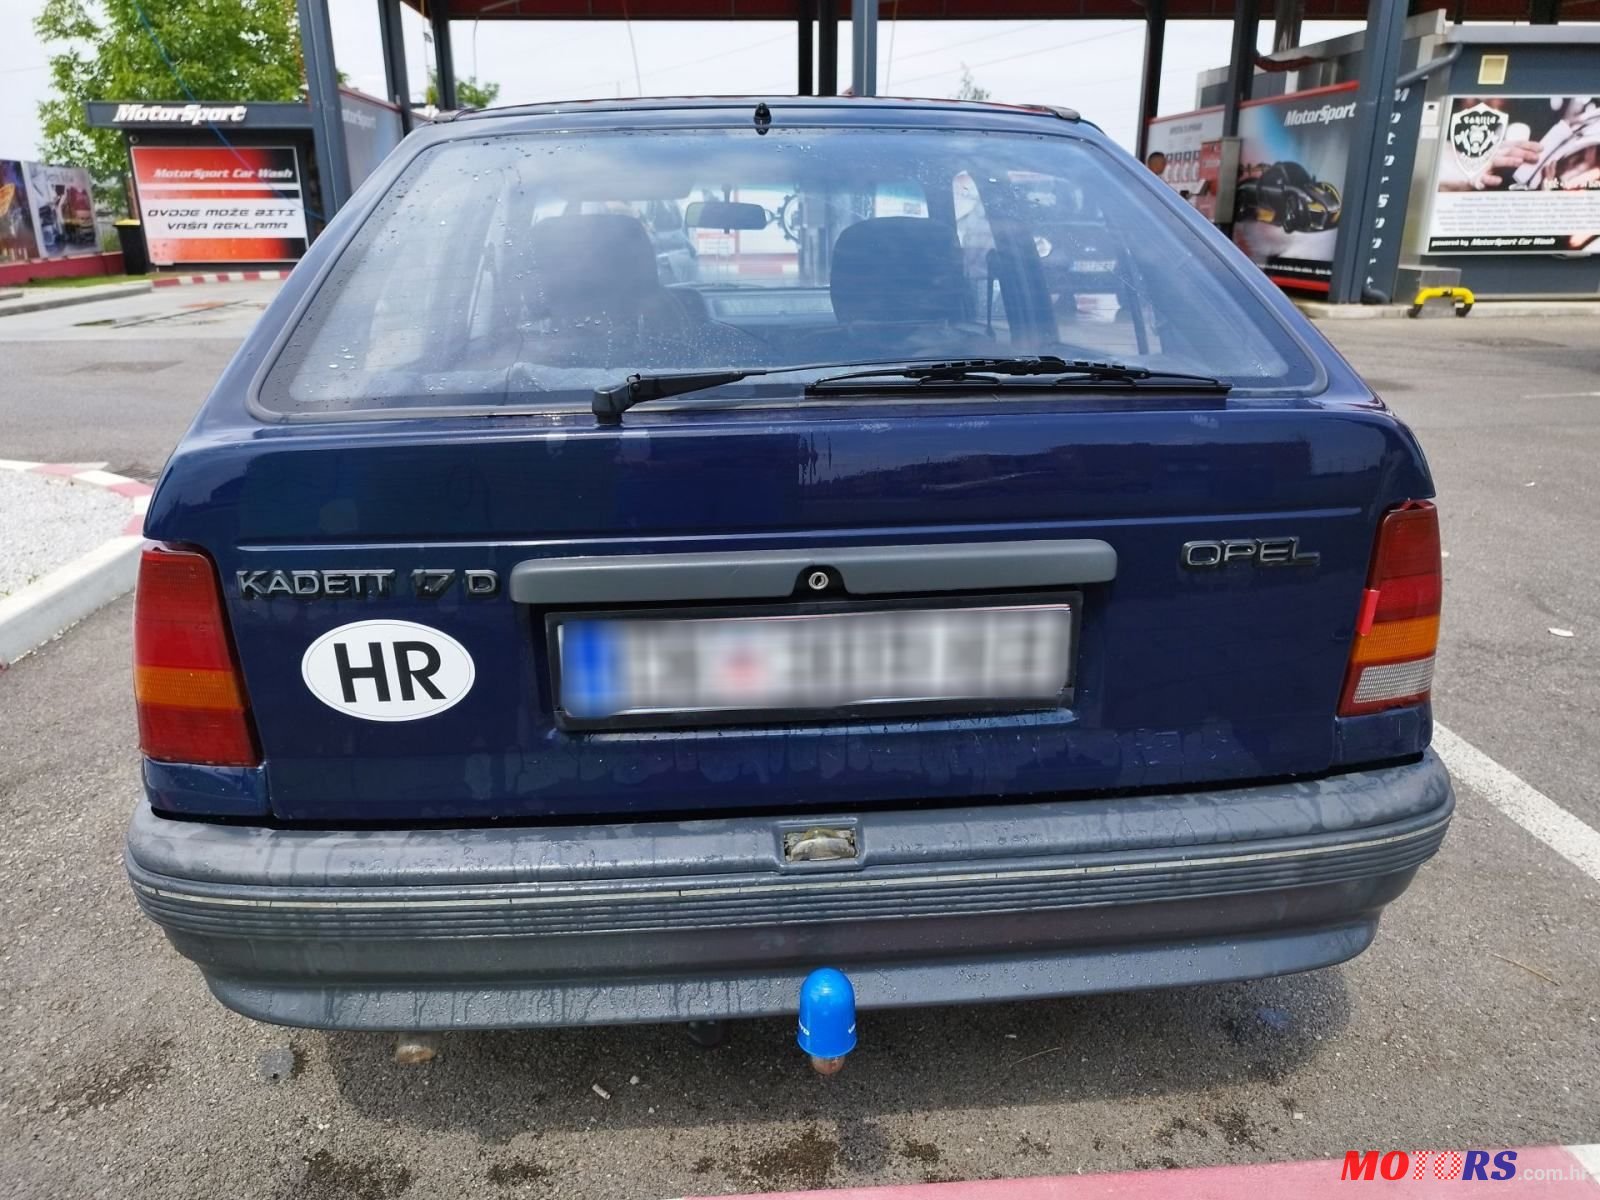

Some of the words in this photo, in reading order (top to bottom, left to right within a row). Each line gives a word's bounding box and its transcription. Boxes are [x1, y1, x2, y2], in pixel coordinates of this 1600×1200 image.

[112, 104, 247, 125] MotorSport
[1284, 102, 1357, 127] MotorSport
[153, 168, 230, 179] MotorSport
[231, 168, 255, 179] Car
[256, 168, 294, 178] Wash
[205, 206, 250, 217] MOŽE
[254, 208, 297, 217] BITI
[167, 221, 208, 231] VAŠA
[212, 221, 289, 230] REKLAMA
[1181, 535, 1320, 569] OPEL
[236, 569, 395, 597] KADETT
[464, 569, 499, 597] D
[333, 640, 448, 703] HR
